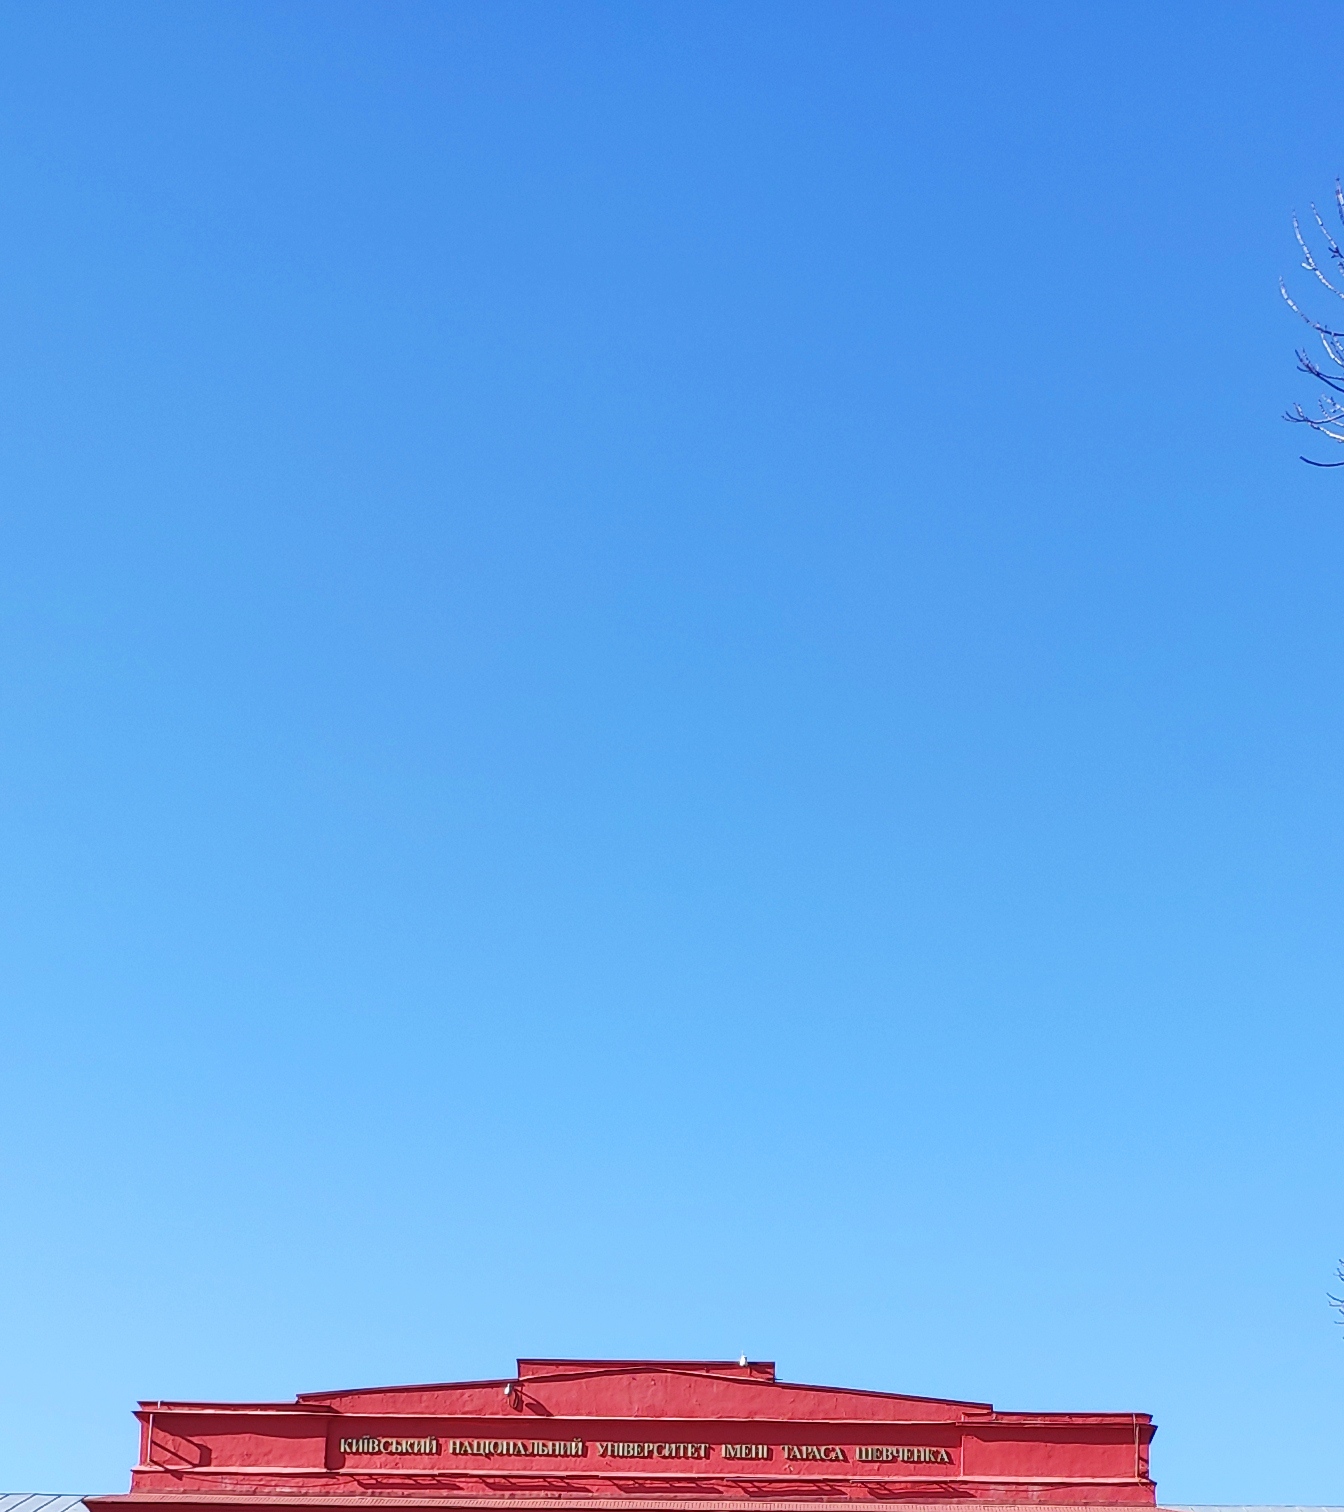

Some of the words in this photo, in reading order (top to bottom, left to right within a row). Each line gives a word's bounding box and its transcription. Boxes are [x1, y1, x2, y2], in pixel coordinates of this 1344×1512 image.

[340, 1435, 437, 1454] КИЇВСЬКИЙ
[449, 1438, 584, 1458] НАЦІОНАЛЬНИЙ
[596, 1442, 709, 1458] УНІВЕРСИТЕТ
[721, 1444, 768, 1459] ІМЕНІ
[782, 1445, 844, 1460] ТАРАСА
[856, 1446, 950, 1462] ШЕВЧЕНКА
